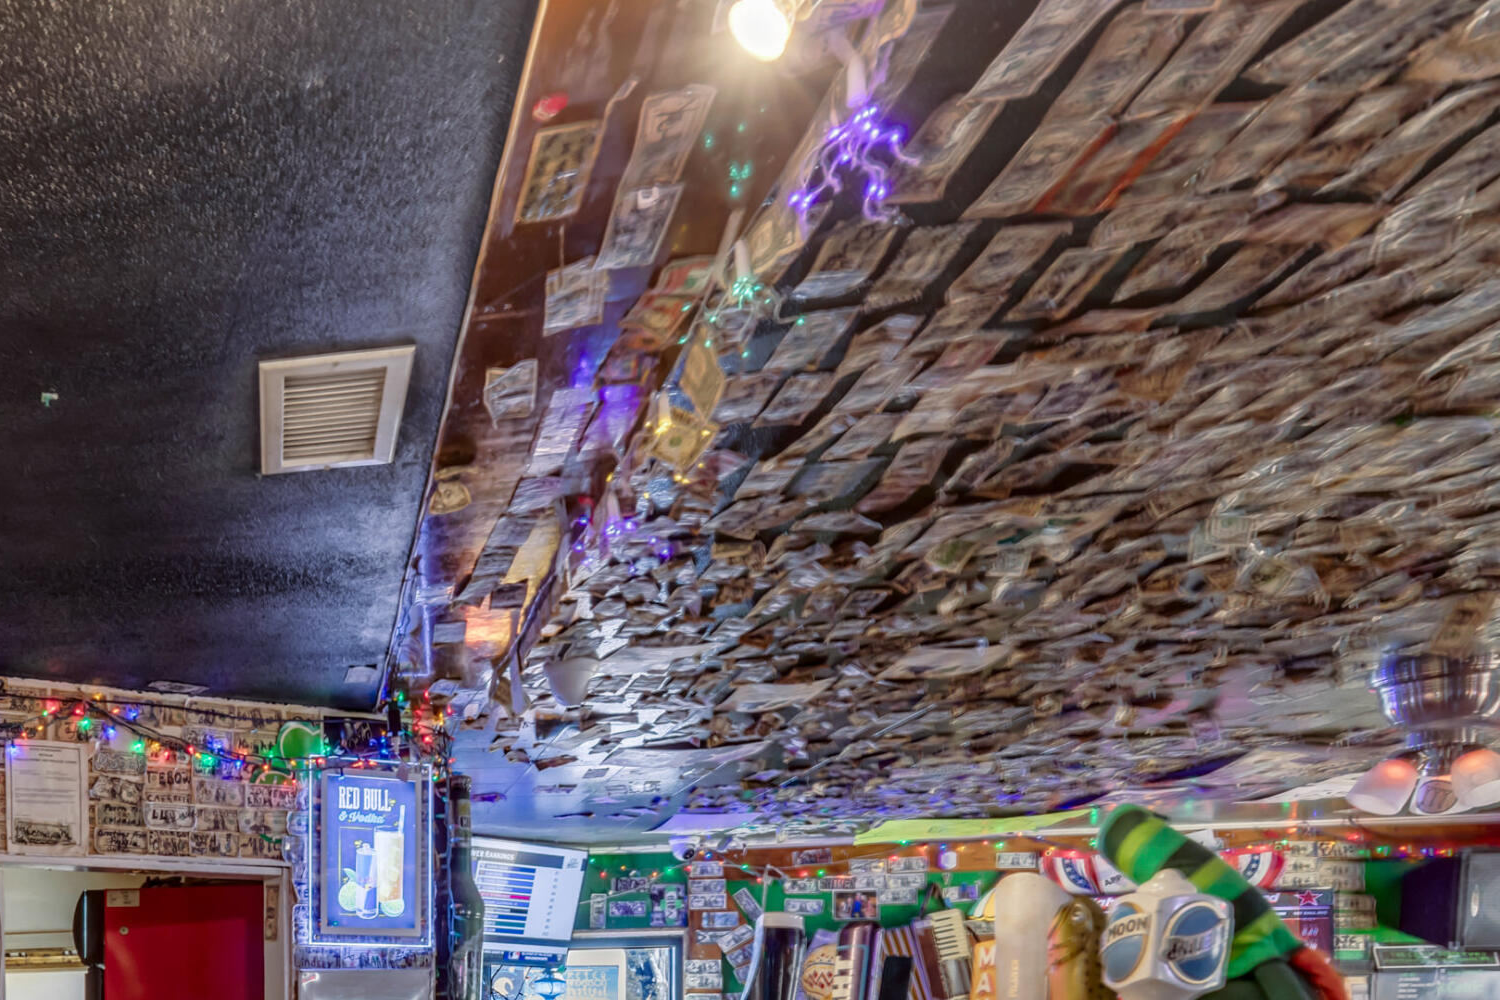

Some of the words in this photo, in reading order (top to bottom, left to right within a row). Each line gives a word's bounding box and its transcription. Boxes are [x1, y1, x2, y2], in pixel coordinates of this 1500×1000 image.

[338, 785, 360, 811] RED
[363, 787, 393, 812] BULL
[348, 810, 386, 825] Vodka
[1107, 916, 1149, 939] MOON
